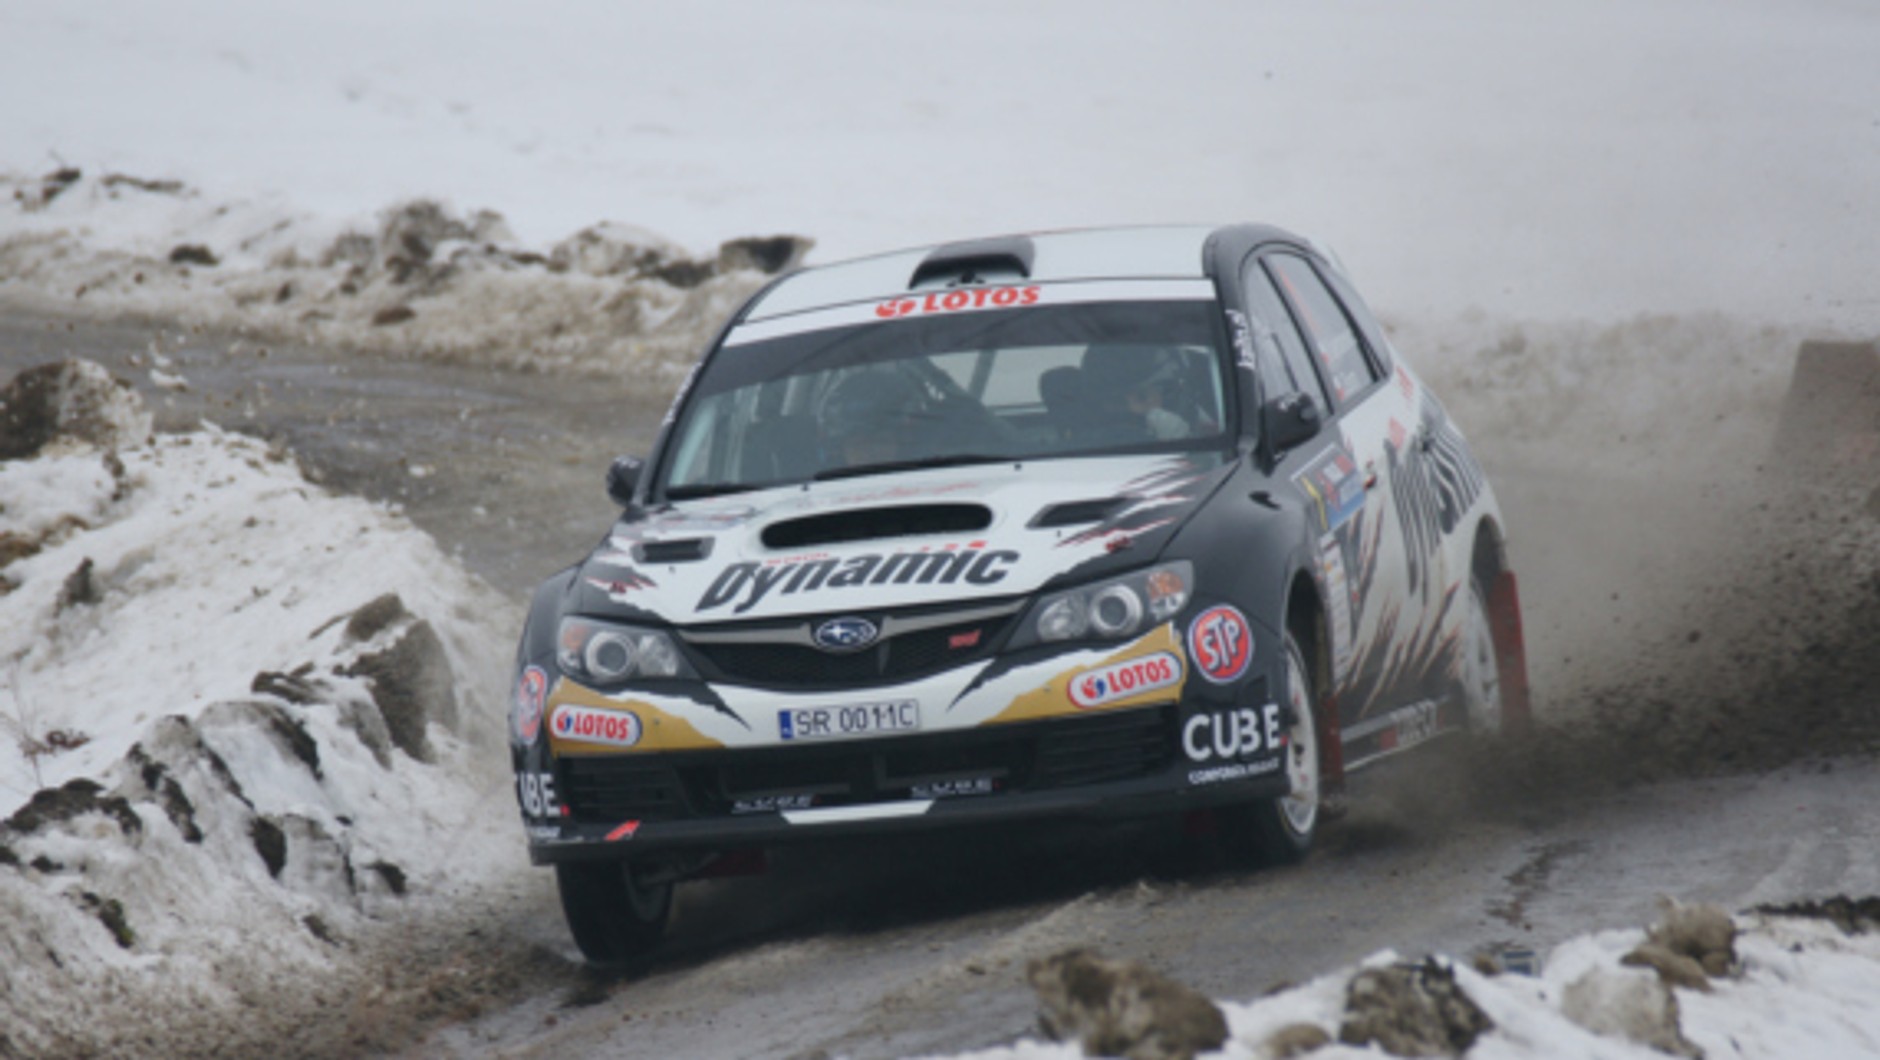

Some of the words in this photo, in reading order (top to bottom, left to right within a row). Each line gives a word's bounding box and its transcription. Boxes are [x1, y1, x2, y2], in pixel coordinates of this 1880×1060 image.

[922, 286, 1041, 313] LOTOS
[695, 545, 1021, 614] Dynamic
[1201, 613, 1242, 672] STP
[1107, 657, 1173, 694] LOTOS
[573, 712, 630, 741] LOTOS
[796, 709, 831, 736] SR
[839, 704, 914, 732] 0011C
